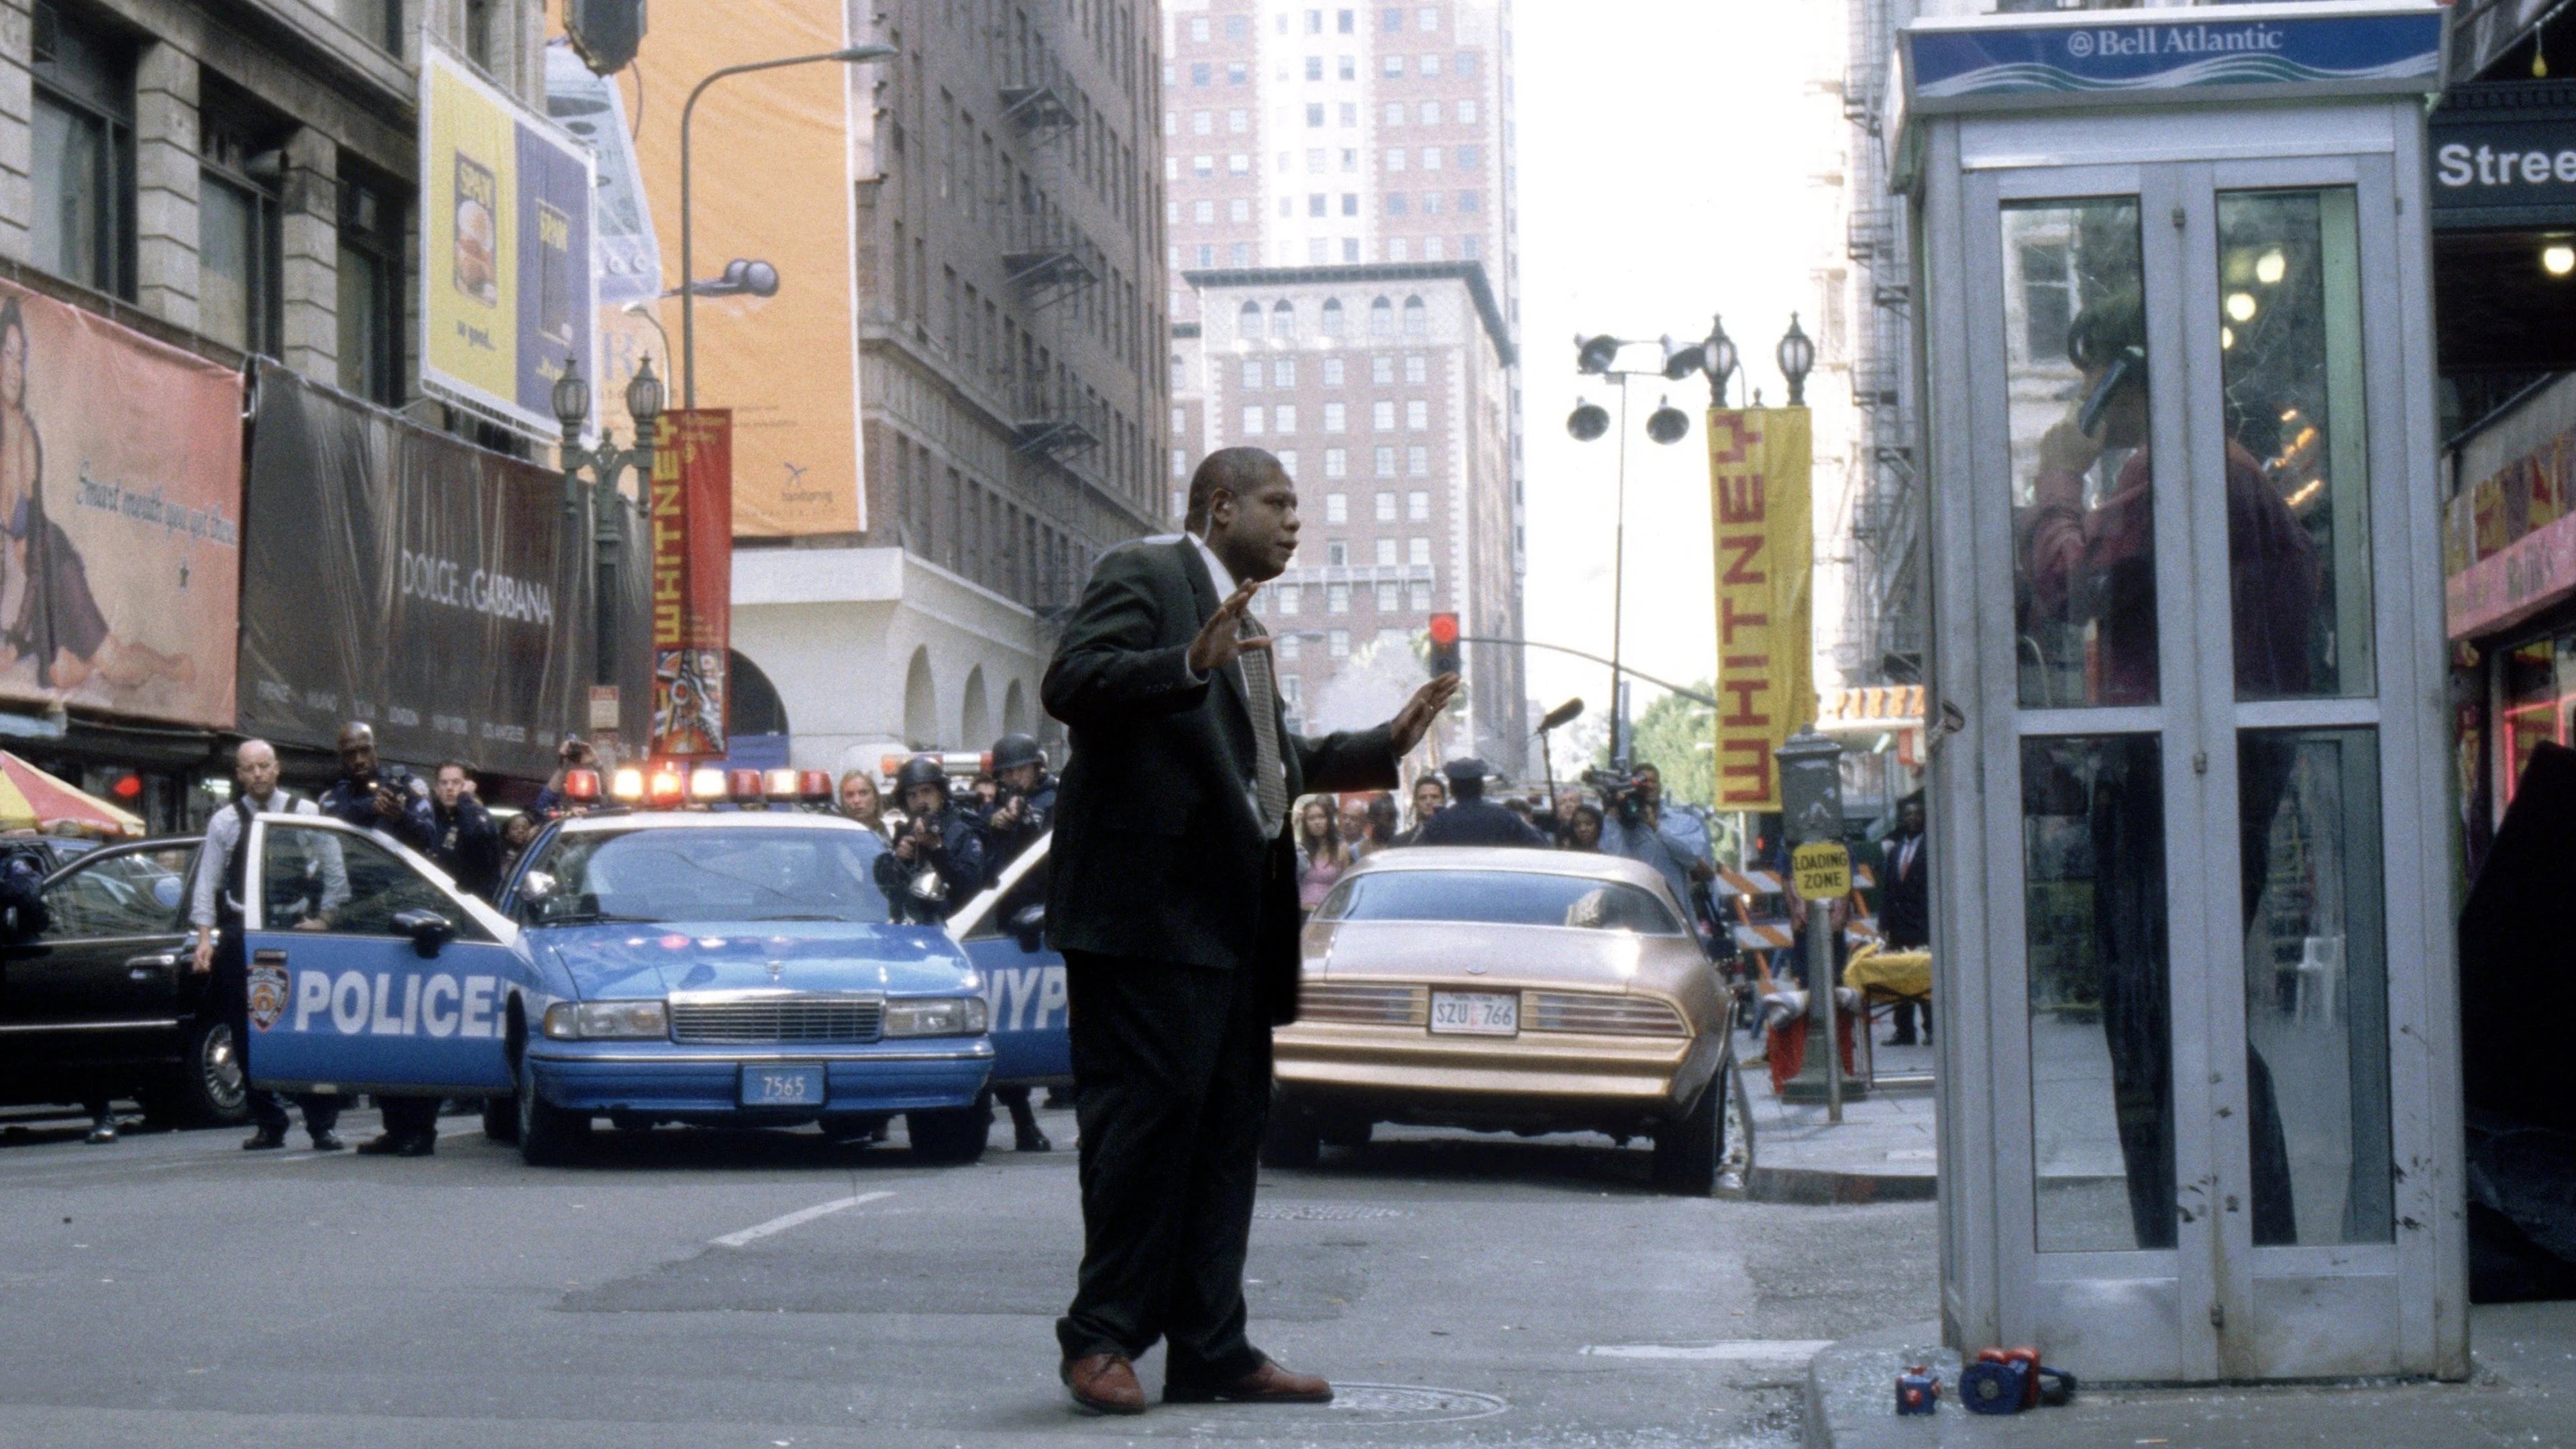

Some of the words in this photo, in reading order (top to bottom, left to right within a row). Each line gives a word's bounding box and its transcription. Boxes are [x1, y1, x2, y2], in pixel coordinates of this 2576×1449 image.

[2098, 27, 2158, 56] Bell
[2162, 23, 2283, 53] Atlantic
[2438, 143, 2576, 186] Stree
[653, 415, 682, 643] WHITNEY
[402, 548, 460, 606] DOLCE
[471, 568, 553, 627] GABBANA
[1713, 413, 1770, 802] WHITNEY
[1794, 851, 1847, 871] LOADING
[1804, 872, 1842, 890] ZONE
[294, 970, 496, 1038] POLICE
[977, 965, 1070, 1033] NYP
[1437, 1002, 1468, 1024] SZU
[1483, 1004, 1513, 1026] 766
[763, 1076, 804, 1097] 7565
